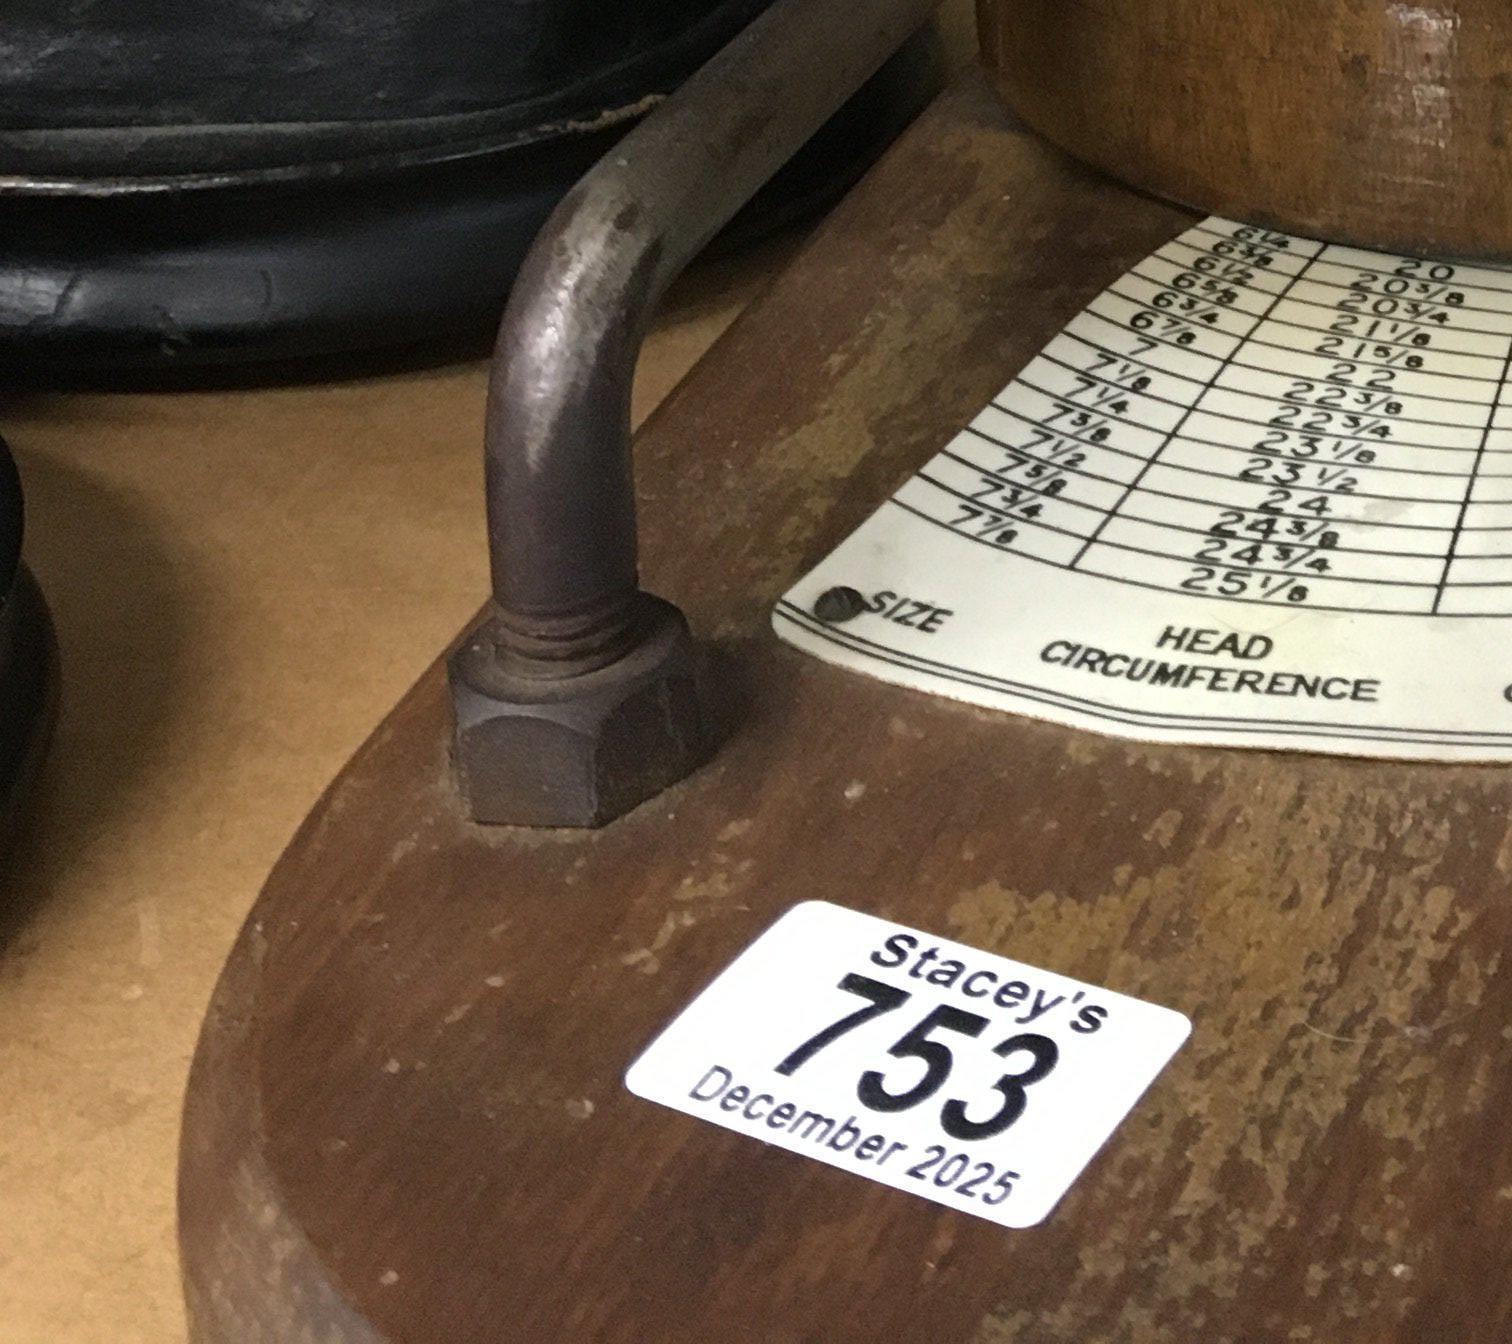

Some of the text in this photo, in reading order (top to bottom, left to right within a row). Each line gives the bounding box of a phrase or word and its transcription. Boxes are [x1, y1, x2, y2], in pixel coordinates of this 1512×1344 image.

[1394, 259, 1455, 281] 20
[1325, 362, 1396, 391] 22
[1257, 489, 1331, 516] 24
[870, 590, 953, 634] SIZE
[1155, 625, 1274, 660] HEAD
[1040, 639, 1381, 703] CIRCUMFERENCE
[870, 933, 1110, 1034] Stacey's
[773, 972, 1059, 1142] 753
[688, 1065, 1021, 1206] December 2025
